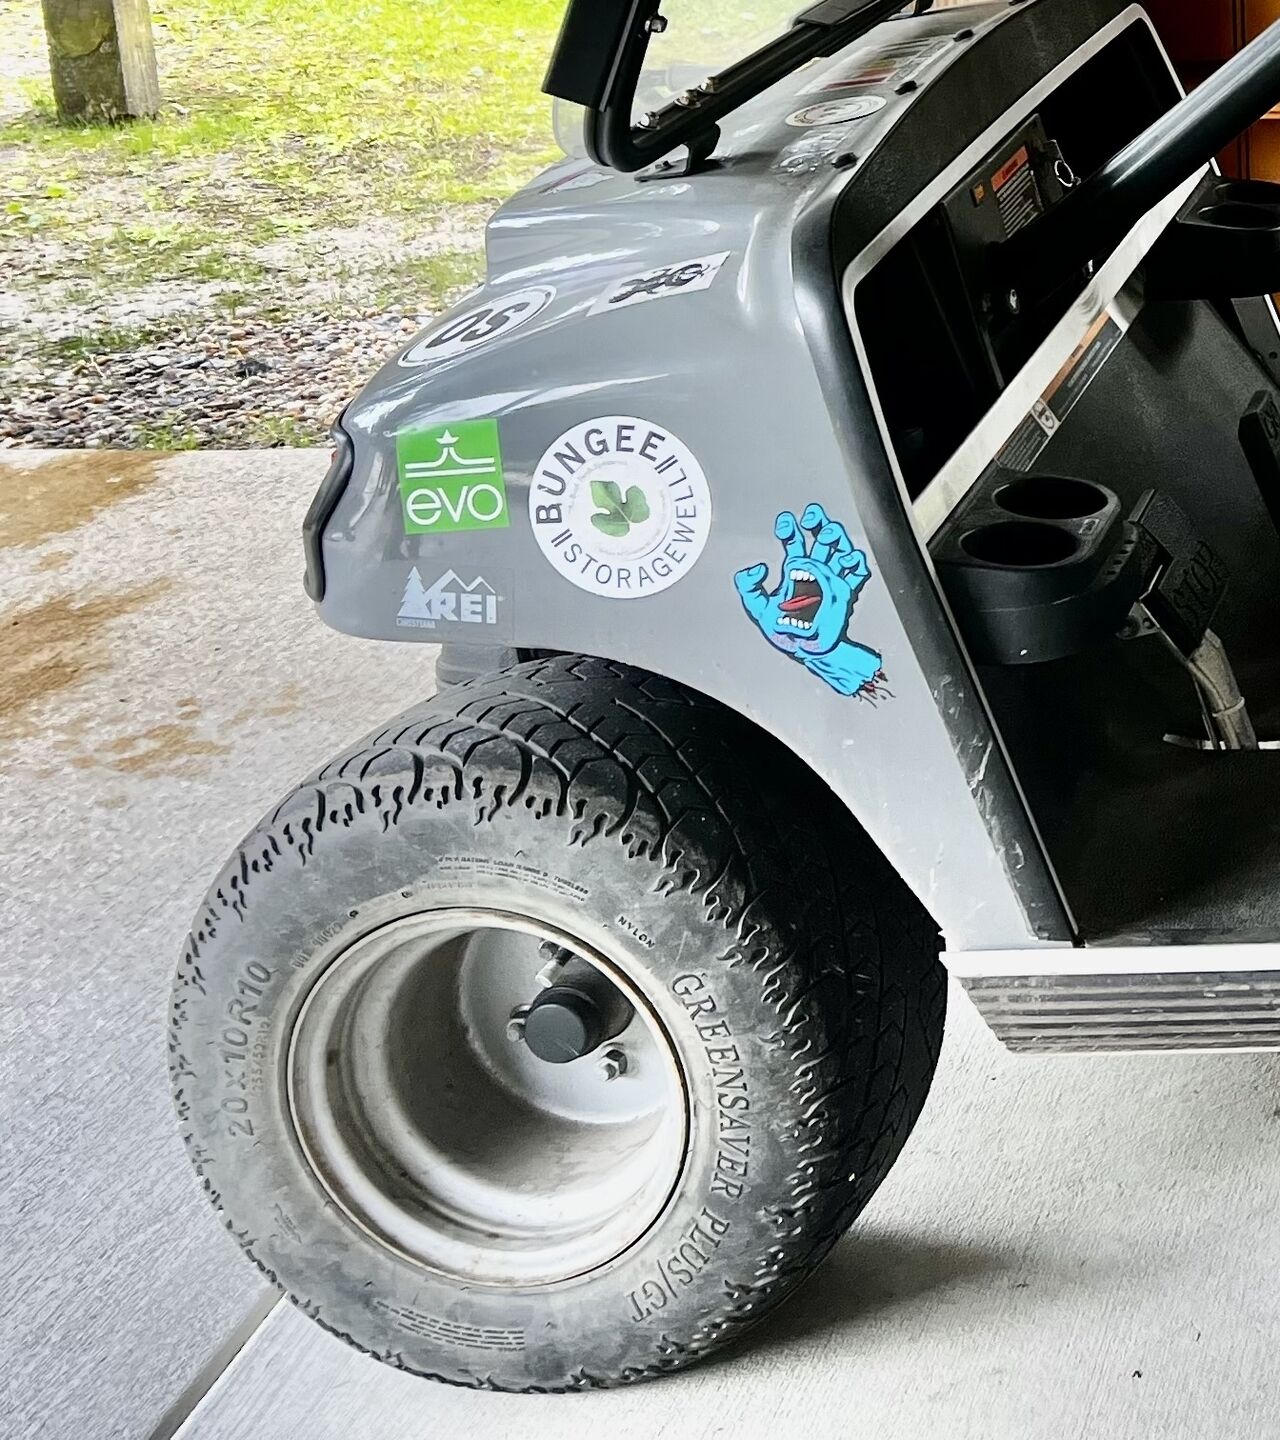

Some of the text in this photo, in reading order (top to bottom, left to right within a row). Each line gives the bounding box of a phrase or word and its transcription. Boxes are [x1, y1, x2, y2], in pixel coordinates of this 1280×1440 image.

[536, 424, 666, 524] BUNGEE
[406, 483, 503, 525] evo
[430, 591, 497, 625] REI
[618, 915, 655, 949] NYLON
[630, 973, 751, 1323] GREENSAVER PLUS/GT
